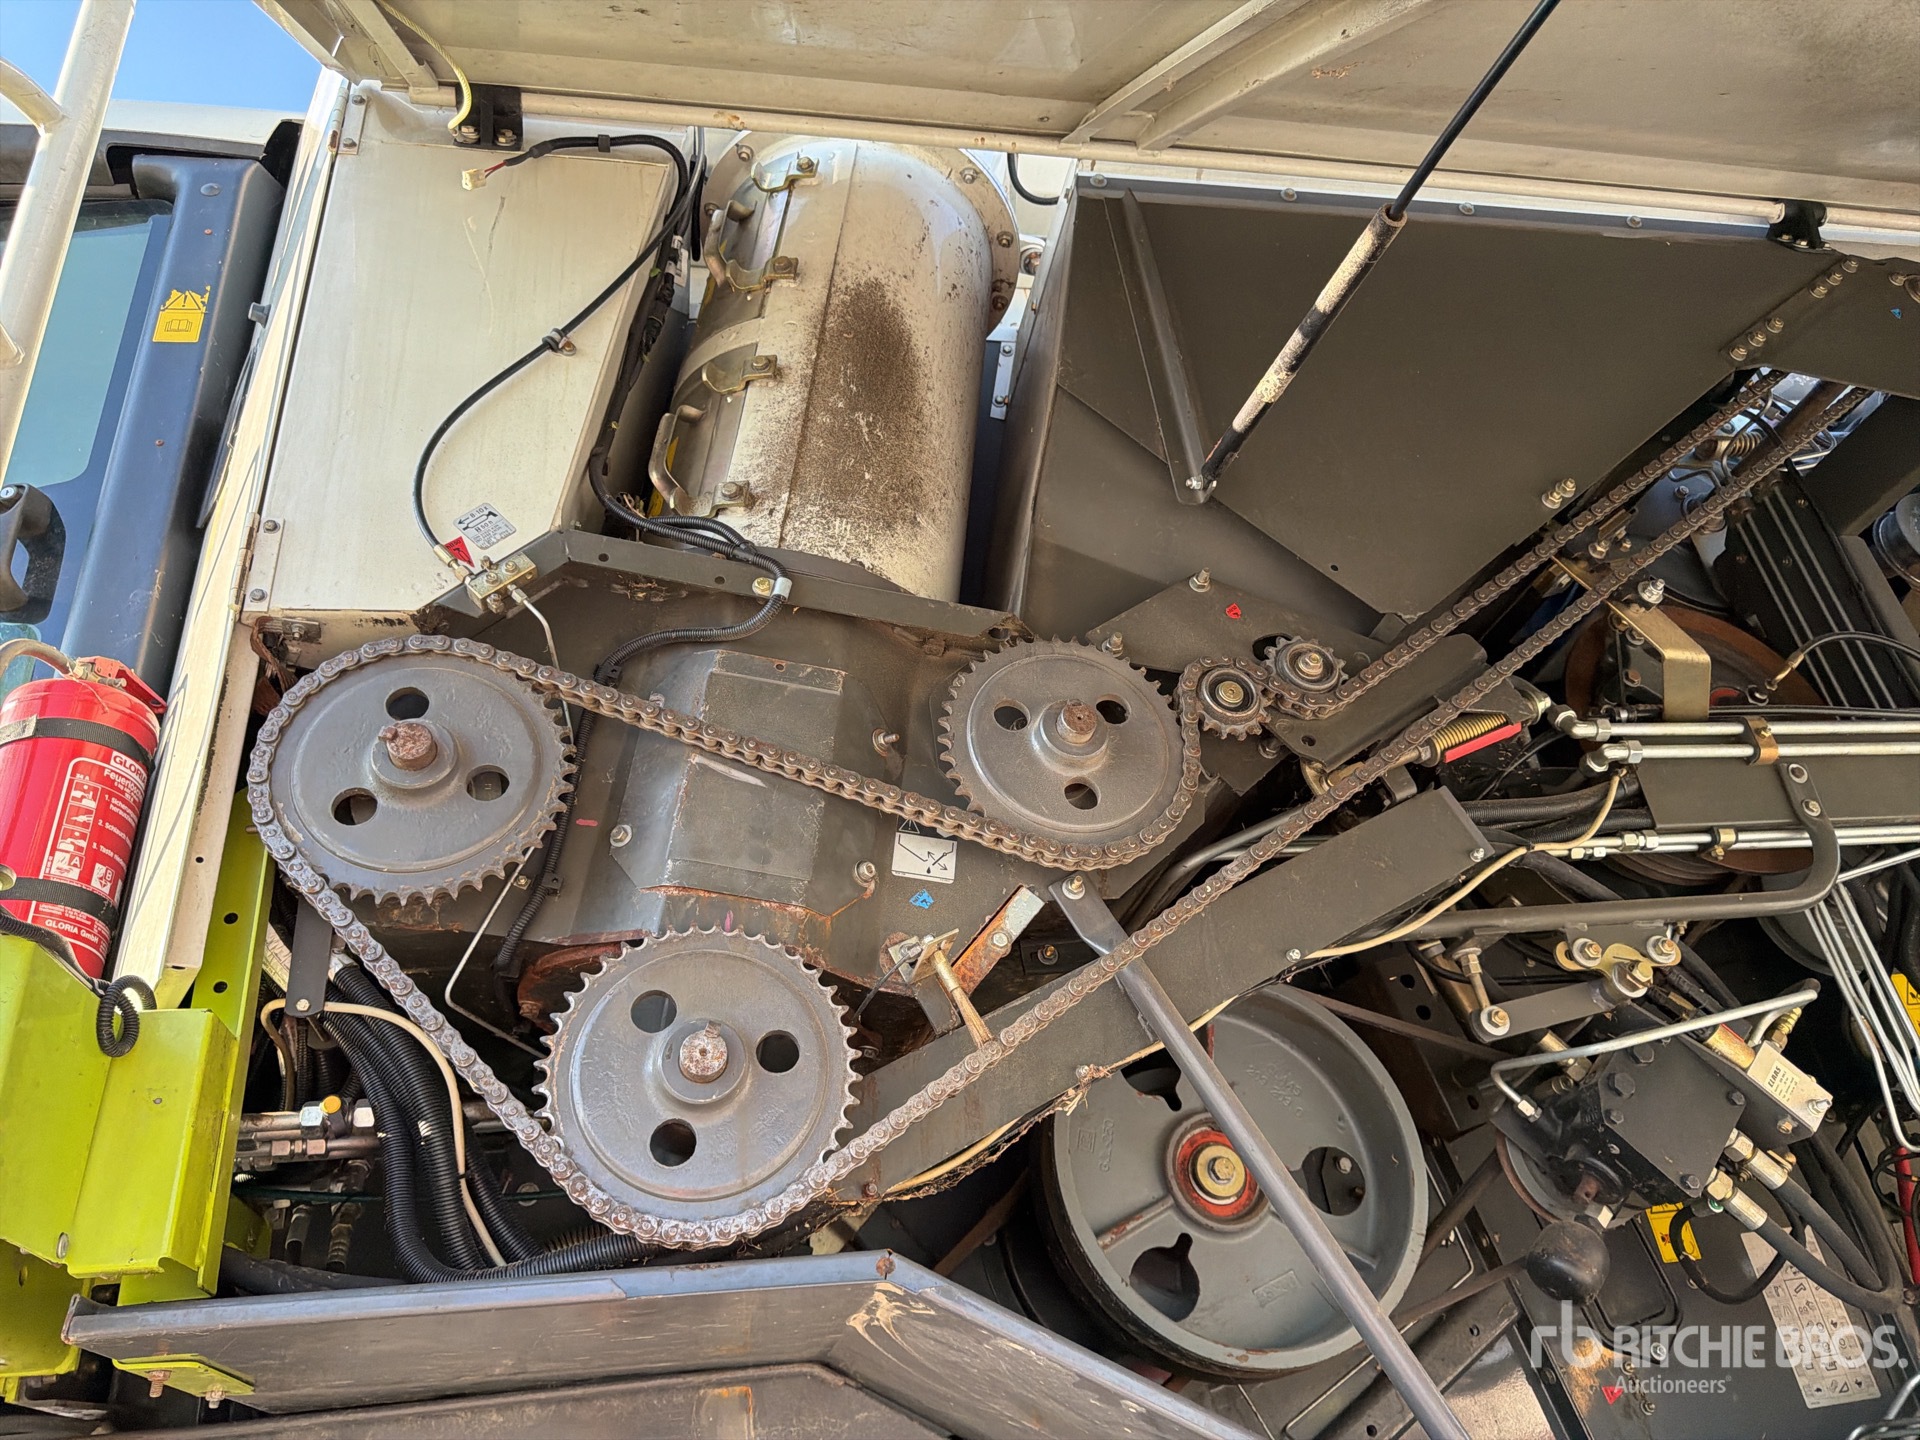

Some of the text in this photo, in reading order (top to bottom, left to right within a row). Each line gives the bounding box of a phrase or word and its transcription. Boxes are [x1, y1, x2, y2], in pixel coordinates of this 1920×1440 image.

[70, 856, 81, 867] A
[105, 870, 113, 881] B
[45, 919, 79, 935] GLORIA
[80, 929, 99, 943] GmbH
[1767, 1065, 1782, 1088] CLAAS
